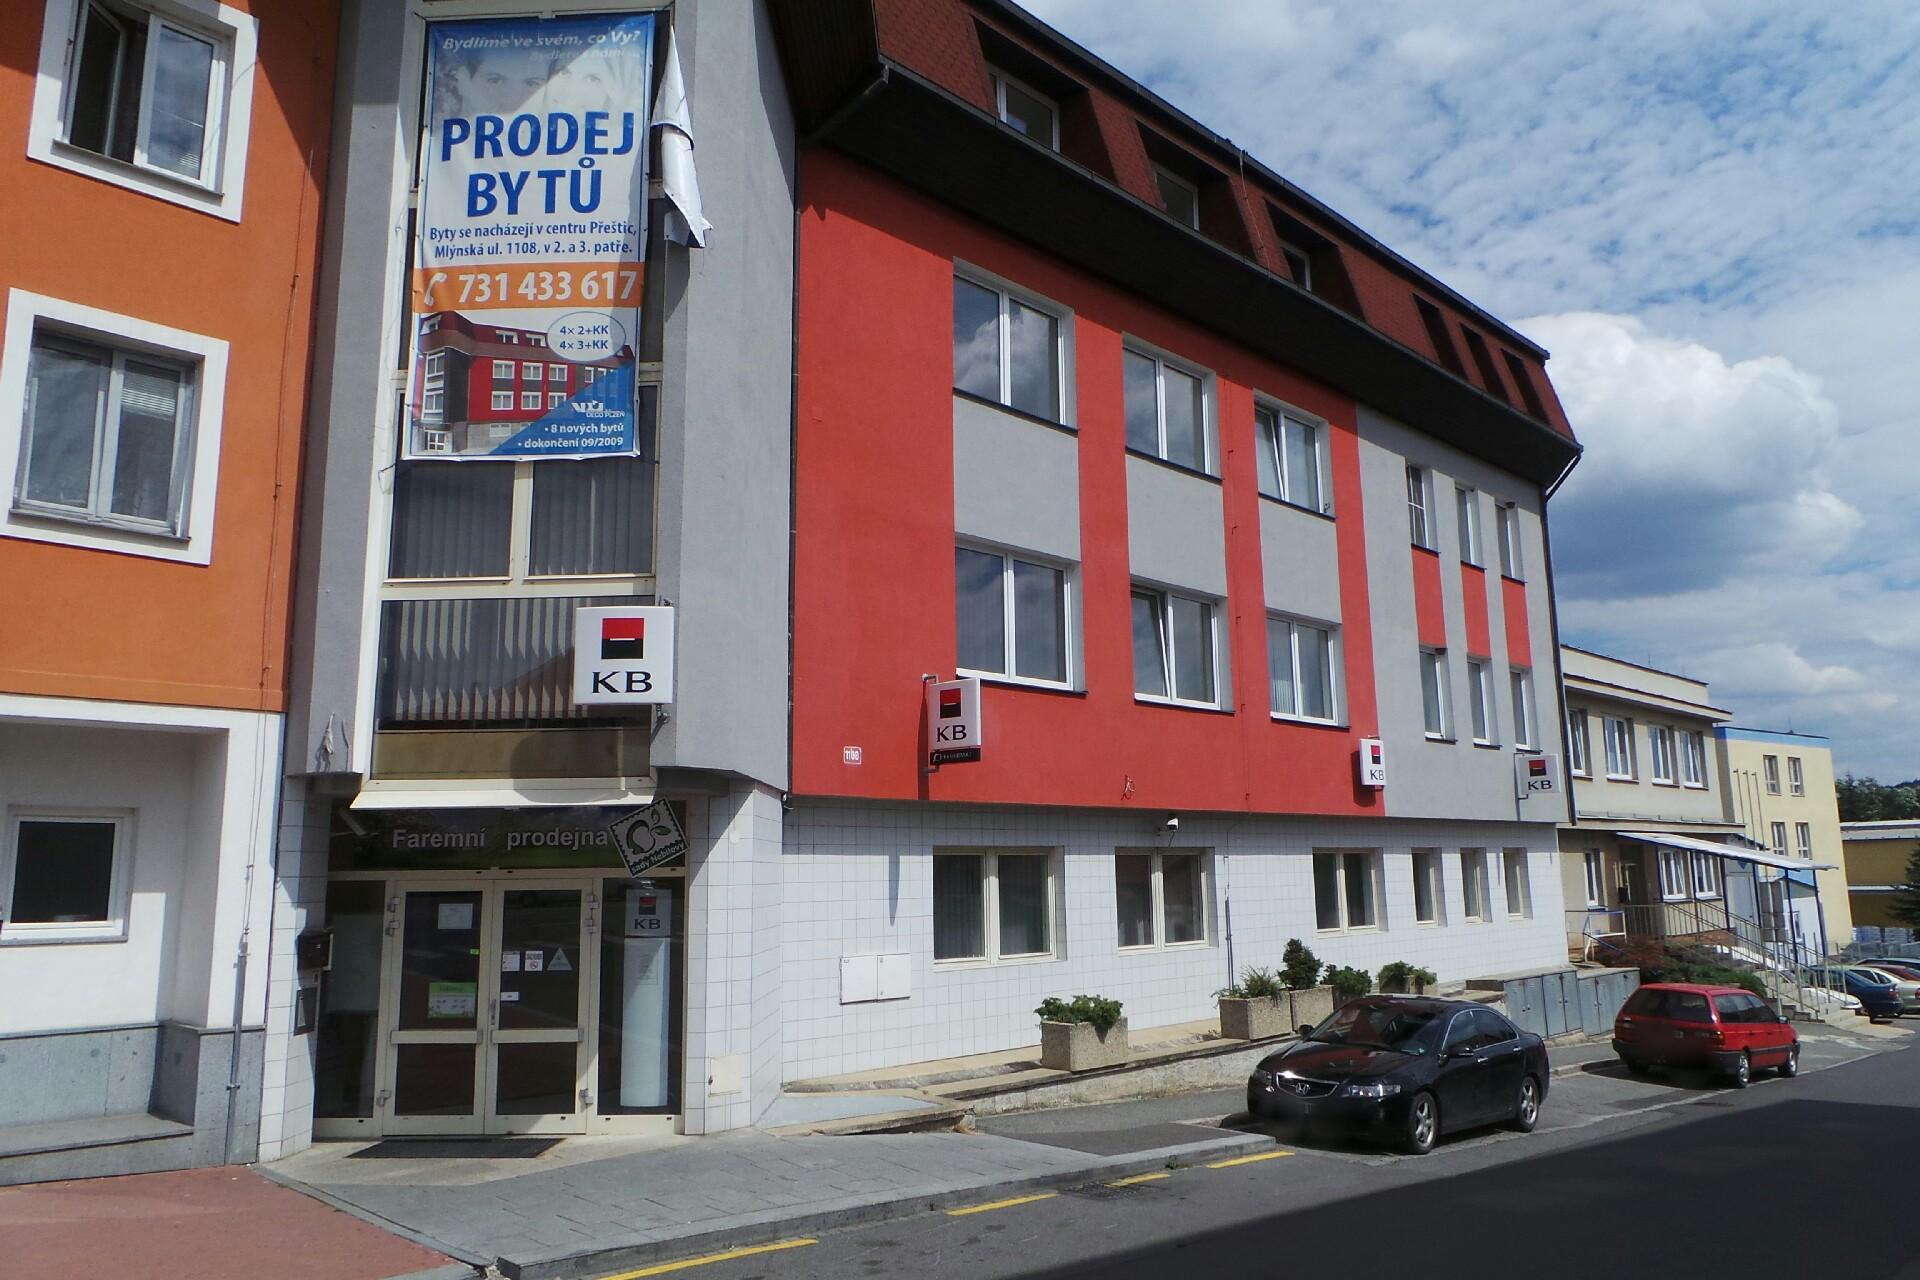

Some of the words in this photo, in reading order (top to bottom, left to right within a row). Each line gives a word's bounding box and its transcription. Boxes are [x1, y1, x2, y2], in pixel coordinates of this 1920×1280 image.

[443, 37, 510, 53] Bydlíme
[513, 38, 533, 48] ve
[536, 34, 583, 48] svém,
[588, 35, 606, 45] co
[610, 30, 641, 46] Vy?
[441, 111, 635, 162] PRODEJ
[467, 156, 602, 218] BYTŮ
[430, 227, 456, 242] Byty
[459, 227, 471, 238] se
[474, 222, 534, 238] nacházejí
[536, 225, 543, 234] v
[546, 222, 586, 234] centru
[590, 220, 637, 236] Přeštic,
[435, 243, 484, 260] Mlýnská
[487, 243, 503, 255] ul.
[507, 241, 540, 255] 1108,
[544, 244, 550, 253] v
[554, 241, 566, 253] 2.
[569, 243, 576, 252] a
[579, 240, 591, 253] 3.
[594, 240, 633, 255] patře.
[458, 272, 509, 303] 731
[518, 271, 572, 301] 433
[581, 270, 637, 300] 617
[578, 325, 609, 335] 2+KK
[577, 340, 609, 349] 3+KK
[551, 424, 558, 433] 8
[560, 423, 598, 435] nových
[600, 422, 624, 434] bytů
[524, 438, 579, 448] dokončení
[581, 436, 624, 448] 09/2009
[592, 671, 653, 694] KB
[937, 724, 967, 743] KB
[1370, 769, 1385, 781] KB
[1528, 780, 1552, 791] KB
[392, 827, 487, 849] Faremní
[507, 827, 608, 850] prodejna
[634, 918, 661, 930] KB
